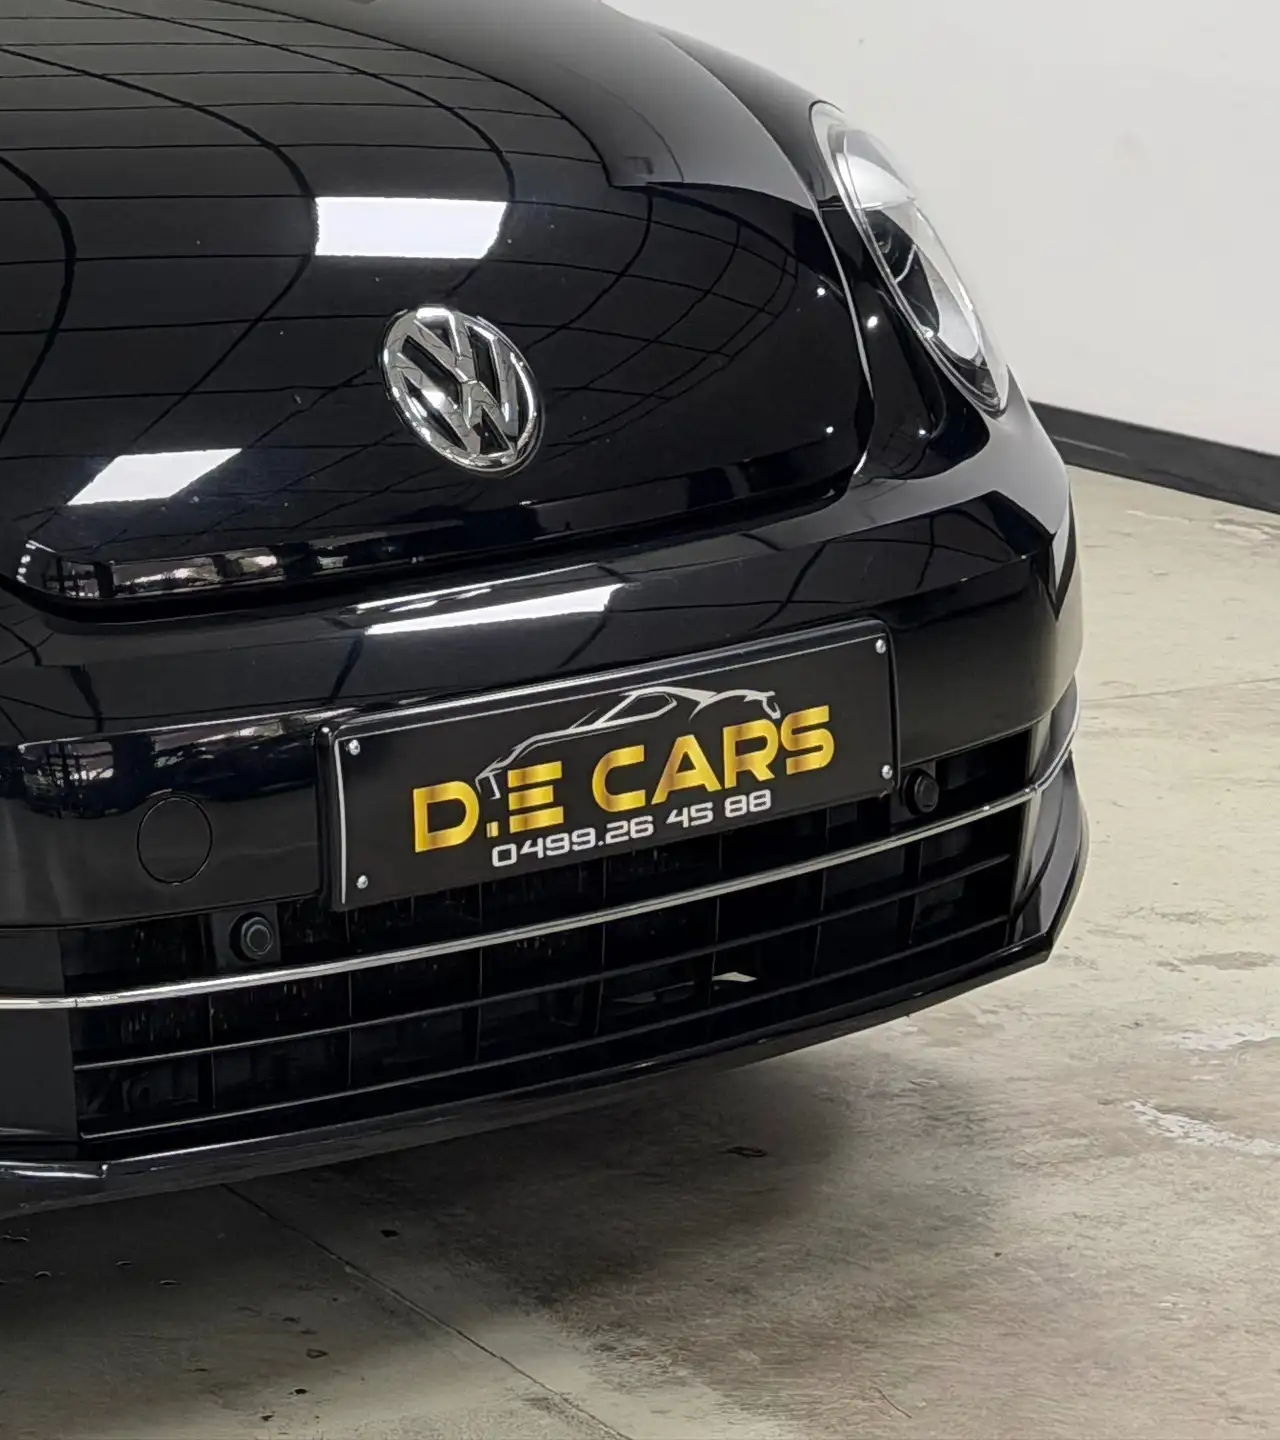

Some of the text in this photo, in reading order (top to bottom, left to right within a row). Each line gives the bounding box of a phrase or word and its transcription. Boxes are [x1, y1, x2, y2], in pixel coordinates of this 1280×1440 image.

[412, 705, 836, 853] D.E CARS
[491, 788, 773, 868] 0499.26 45 88
